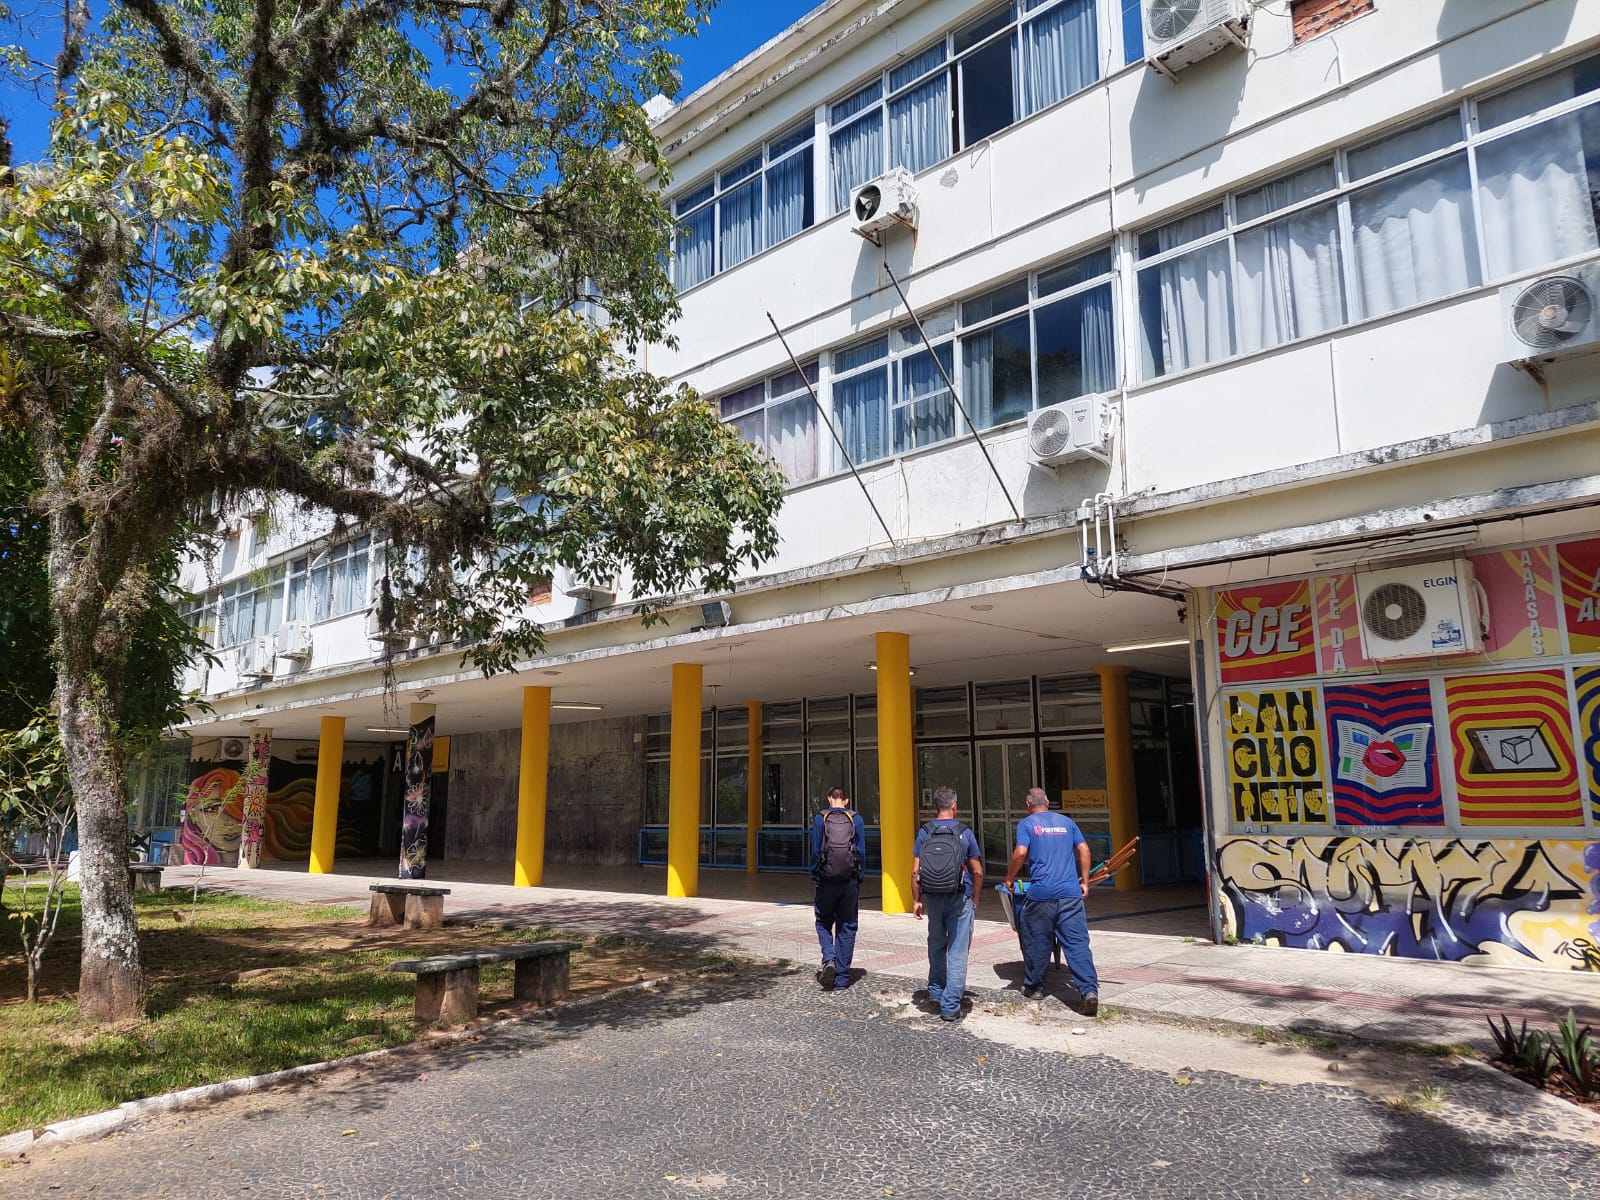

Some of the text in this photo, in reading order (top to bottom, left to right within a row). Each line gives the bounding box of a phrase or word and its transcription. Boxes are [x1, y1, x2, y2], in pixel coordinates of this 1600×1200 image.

[1424, 576, 1458, 588] ELGIN
[1577, 597, 1600, 622] A
[1225, 603, 1305, 659] CCE
